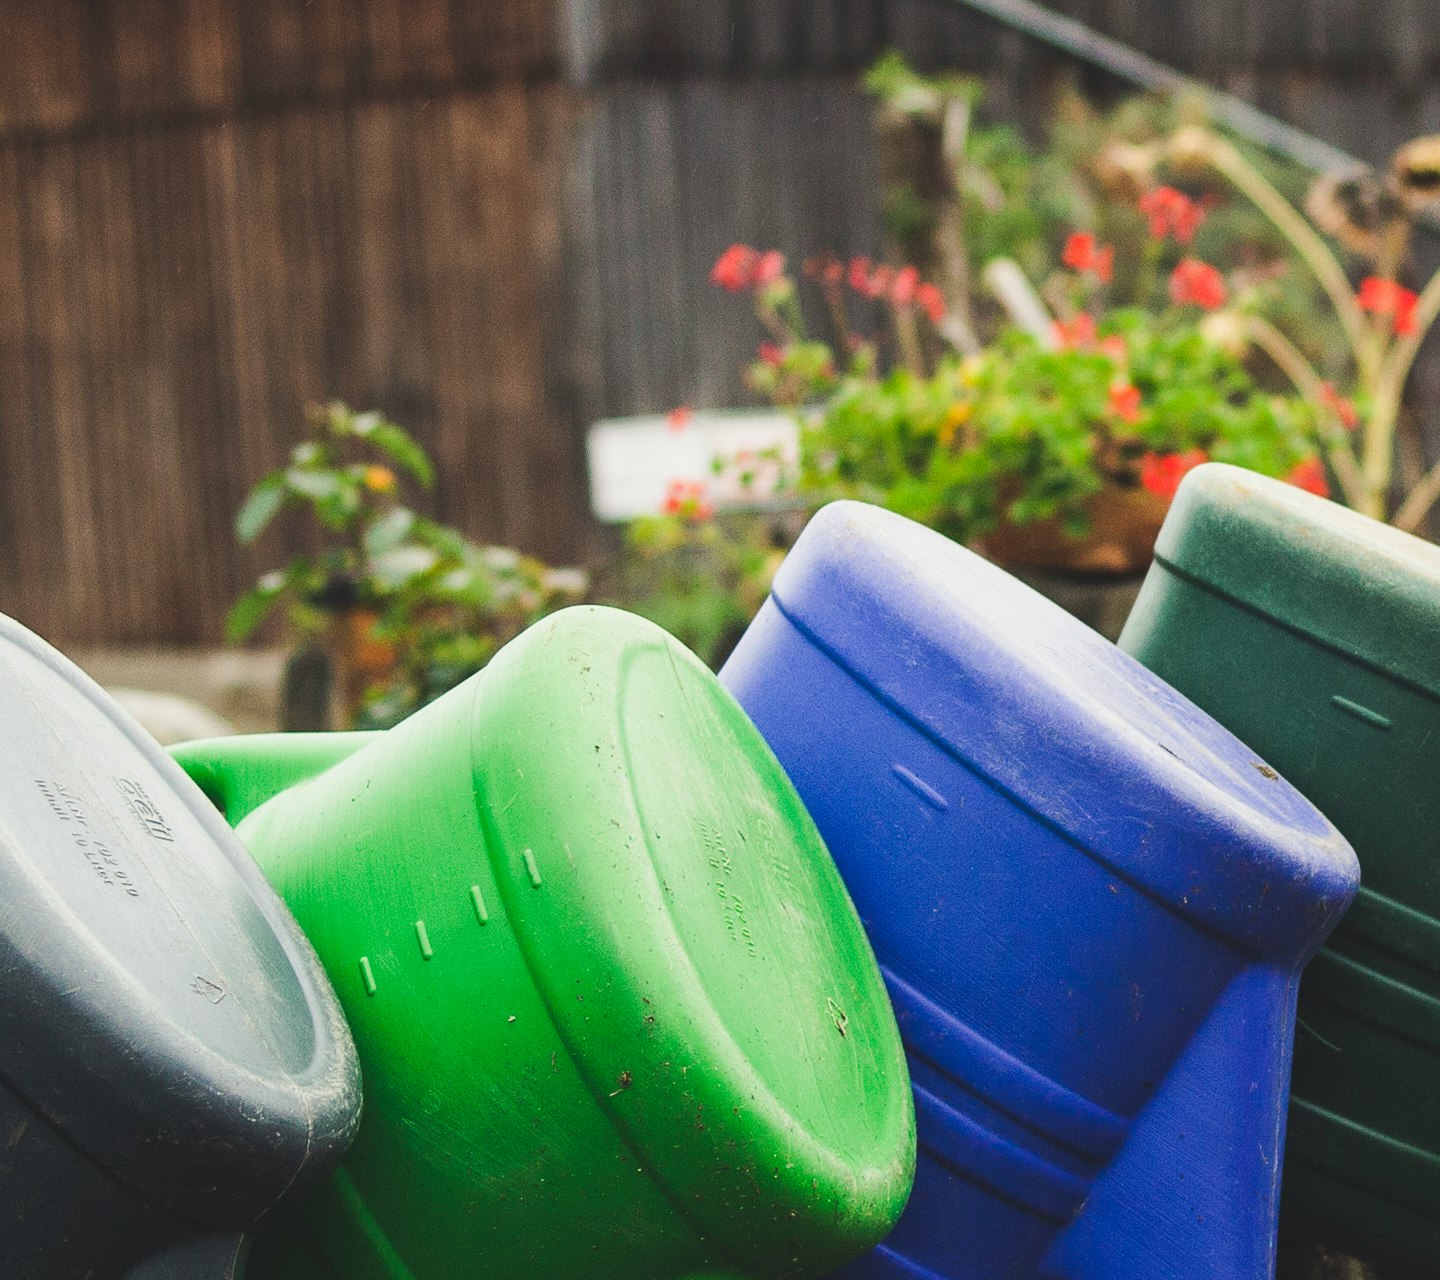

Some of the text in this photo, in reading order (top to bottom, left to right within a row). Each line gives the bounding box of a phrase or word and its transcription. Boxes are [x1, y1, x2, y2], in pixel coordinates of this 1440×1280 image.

[71, 832, 89, 847] 10
[93, 841, 119, 866] 702
[113, 870, 139, 897] 010
